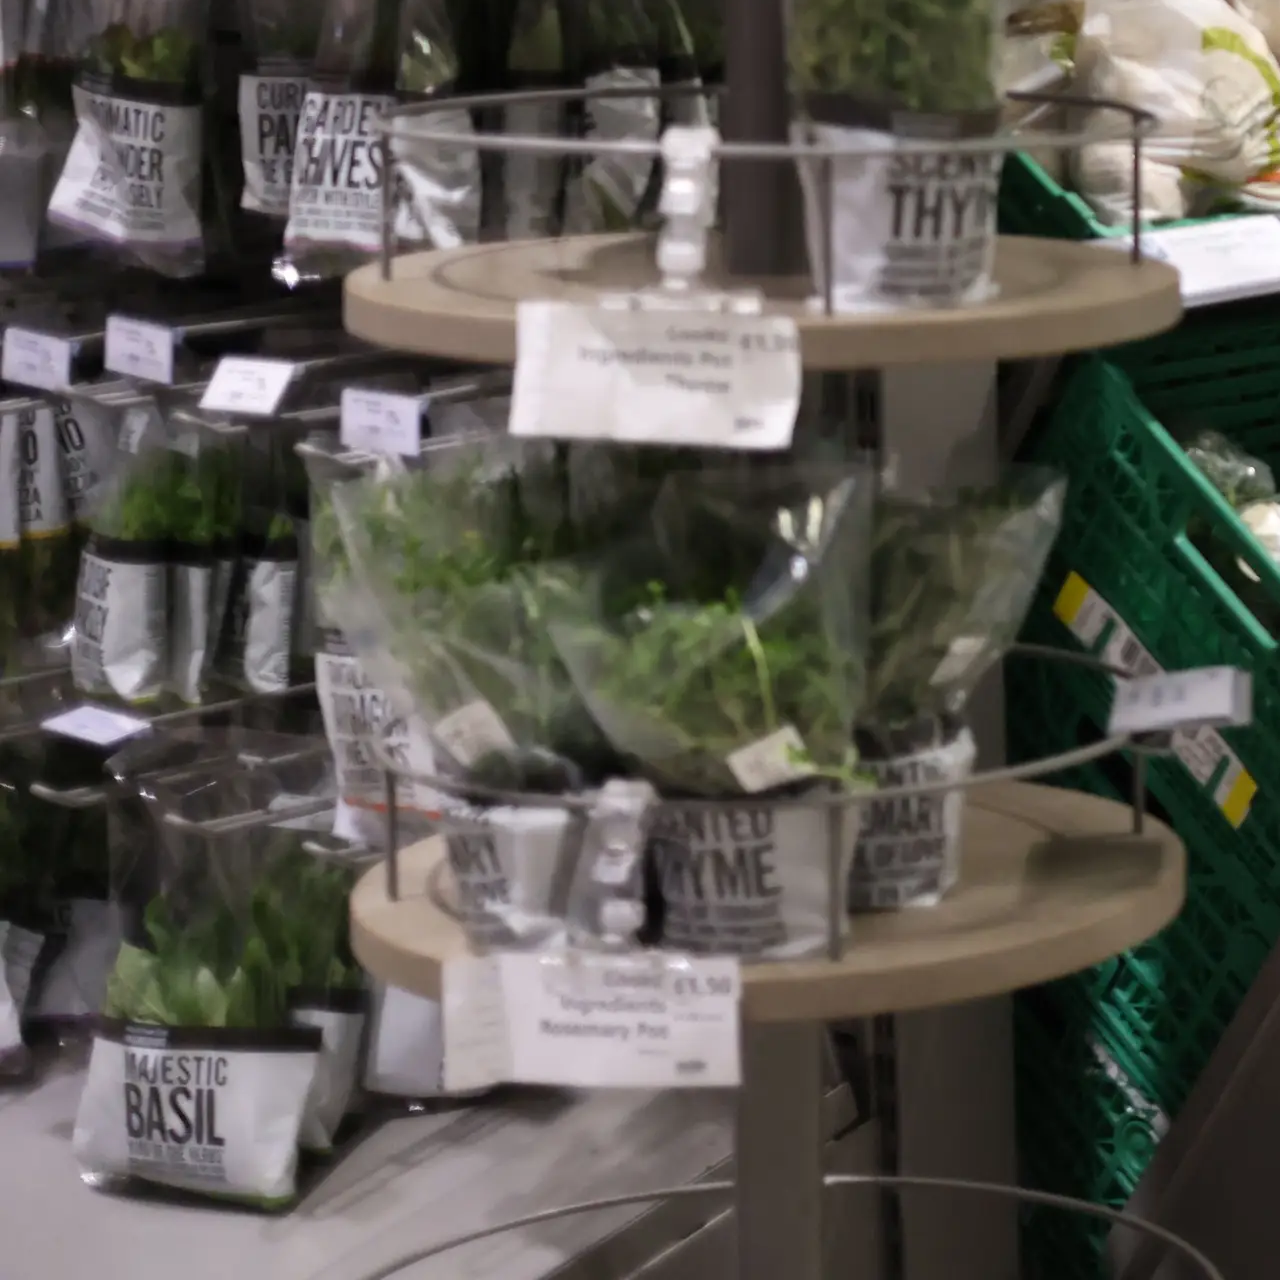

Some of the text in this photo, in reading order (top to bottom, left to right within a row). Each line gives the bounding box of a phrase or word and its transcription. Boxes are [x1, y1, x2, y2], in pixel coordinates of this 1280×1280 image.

[298, 136, 383, 190] CHIVES
[578, 345, 694, 366] Ingredients
[560, 995, 668, 1016] Ingredients
[539, 1019, 669, 1041] Rosemary Pot
[124, 1051, 229, 1087] MAJESTIC
[124, 1081, 226, 1147] BASIL
